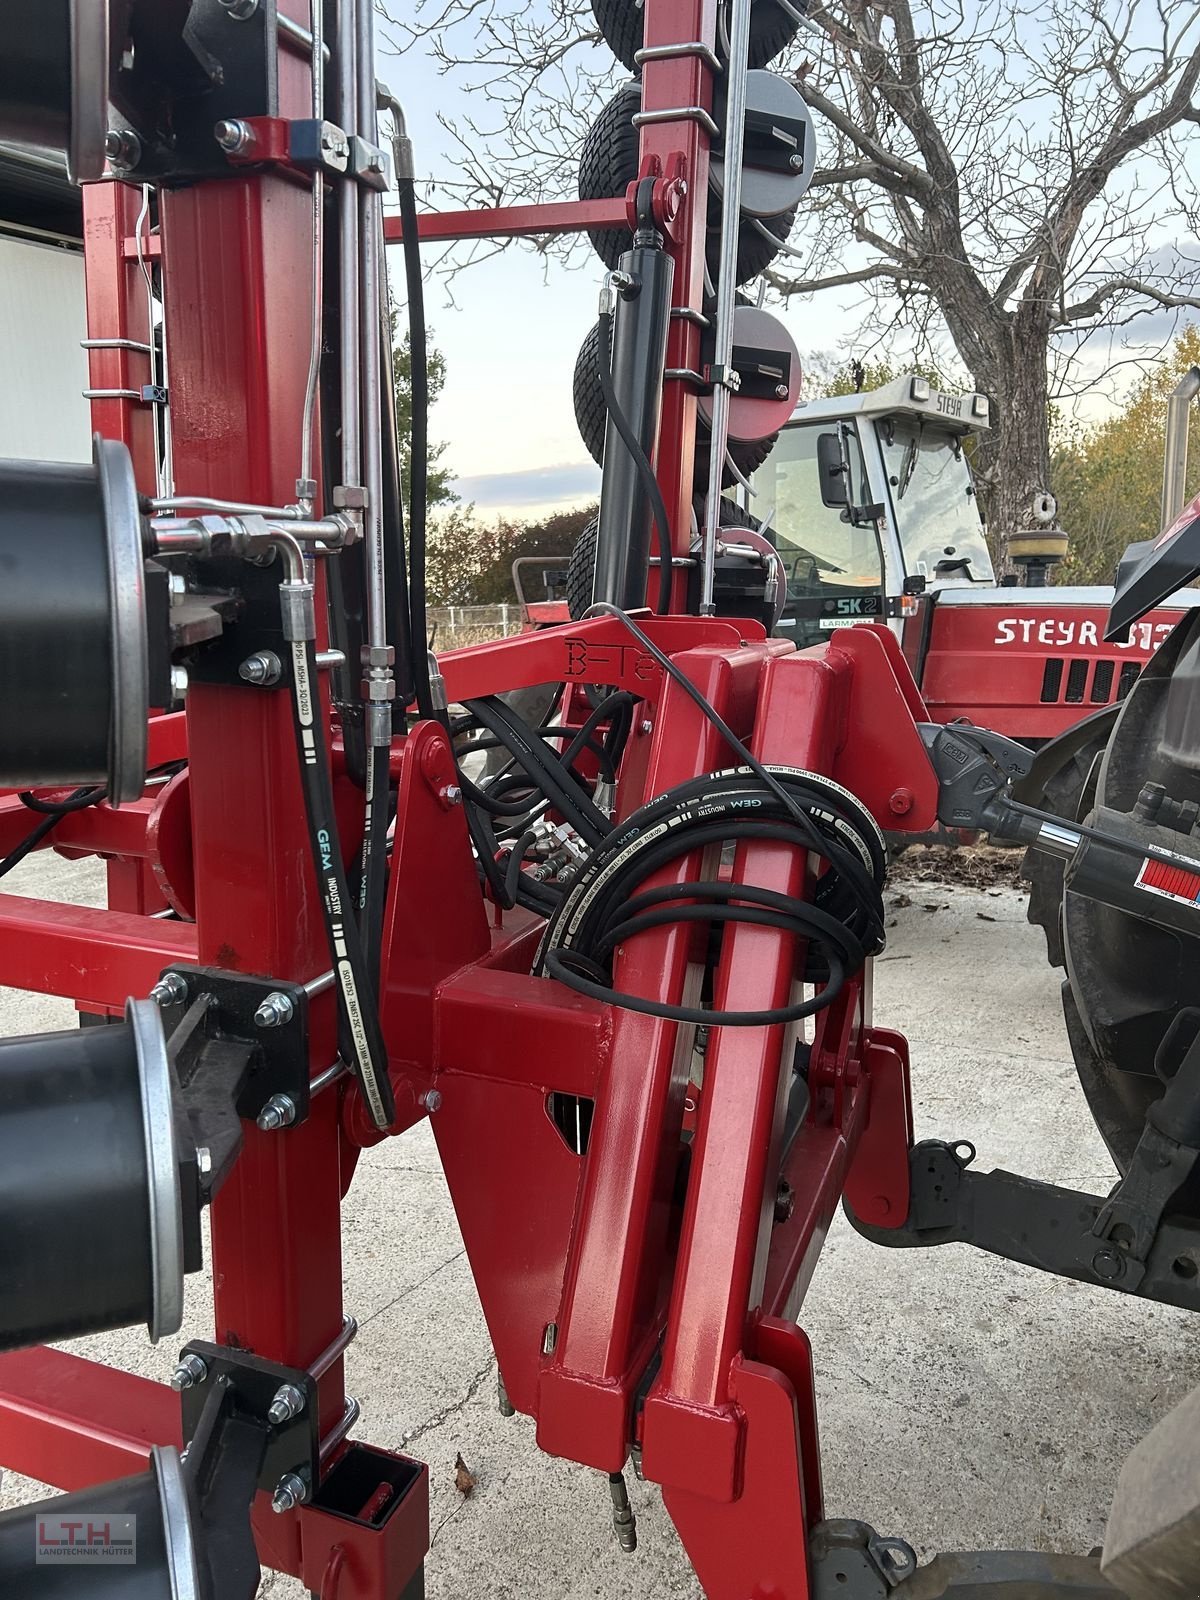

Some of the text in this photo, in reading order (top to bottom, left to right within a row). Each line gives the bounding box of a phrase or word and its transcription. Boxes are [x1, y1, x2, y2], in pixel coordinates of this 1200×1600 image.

[936, 394, 962, 416] STEYR
[994, 619, 1098, 647] STEYR
[297, 665, 307, 685] MSHA
[698, 805, 726, 817] INDUSTRY
[730, 799, 762, 809] GEM
[617, 827, 640, 845] GEM
[317, 829, 333, 871] GEM
[328, 877, 342, 915] INDUSTRY
[342, 969, 354, 996] ISO18752
[349, 1000, 359, 1018] EN857
